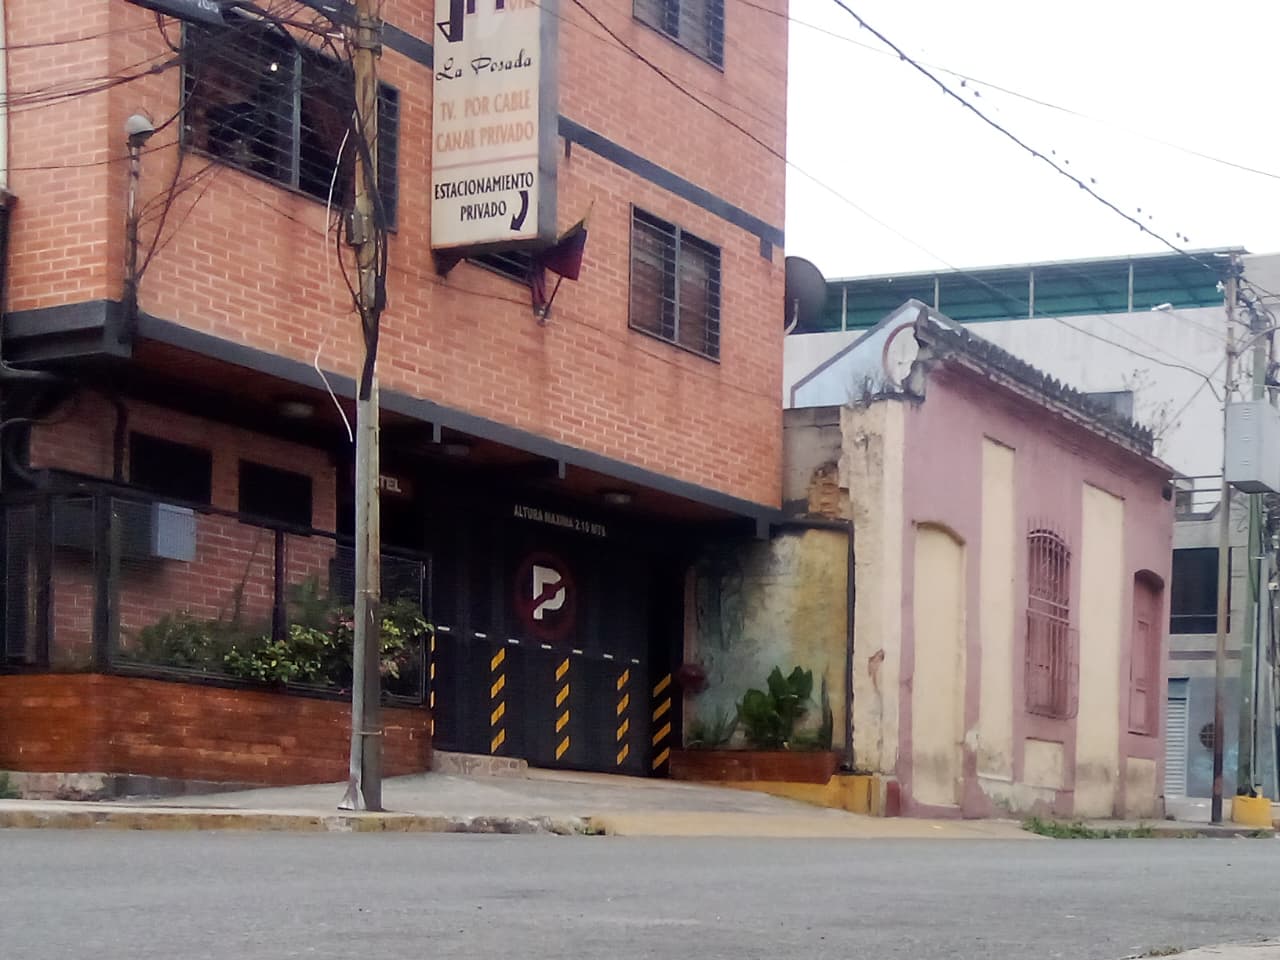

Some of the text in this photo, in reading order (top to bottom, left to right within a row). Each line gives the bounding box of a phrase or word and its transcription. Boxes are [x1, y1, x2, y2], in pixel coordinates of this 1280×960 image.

[435, 48, 532, 81] La Posada
[464, 95, 490, 117] POR
[494, 91, 530, 112] CABLE
[436, 121, 535, 152] CANAL PRIVADO
[435, 172, 534, 200] ESTACIONAMIENTO
[460, 200, 507, 222] PRIVADO
[379, 475, 401, 492] TEL
[513, 503, 544, 522] ALTURA
